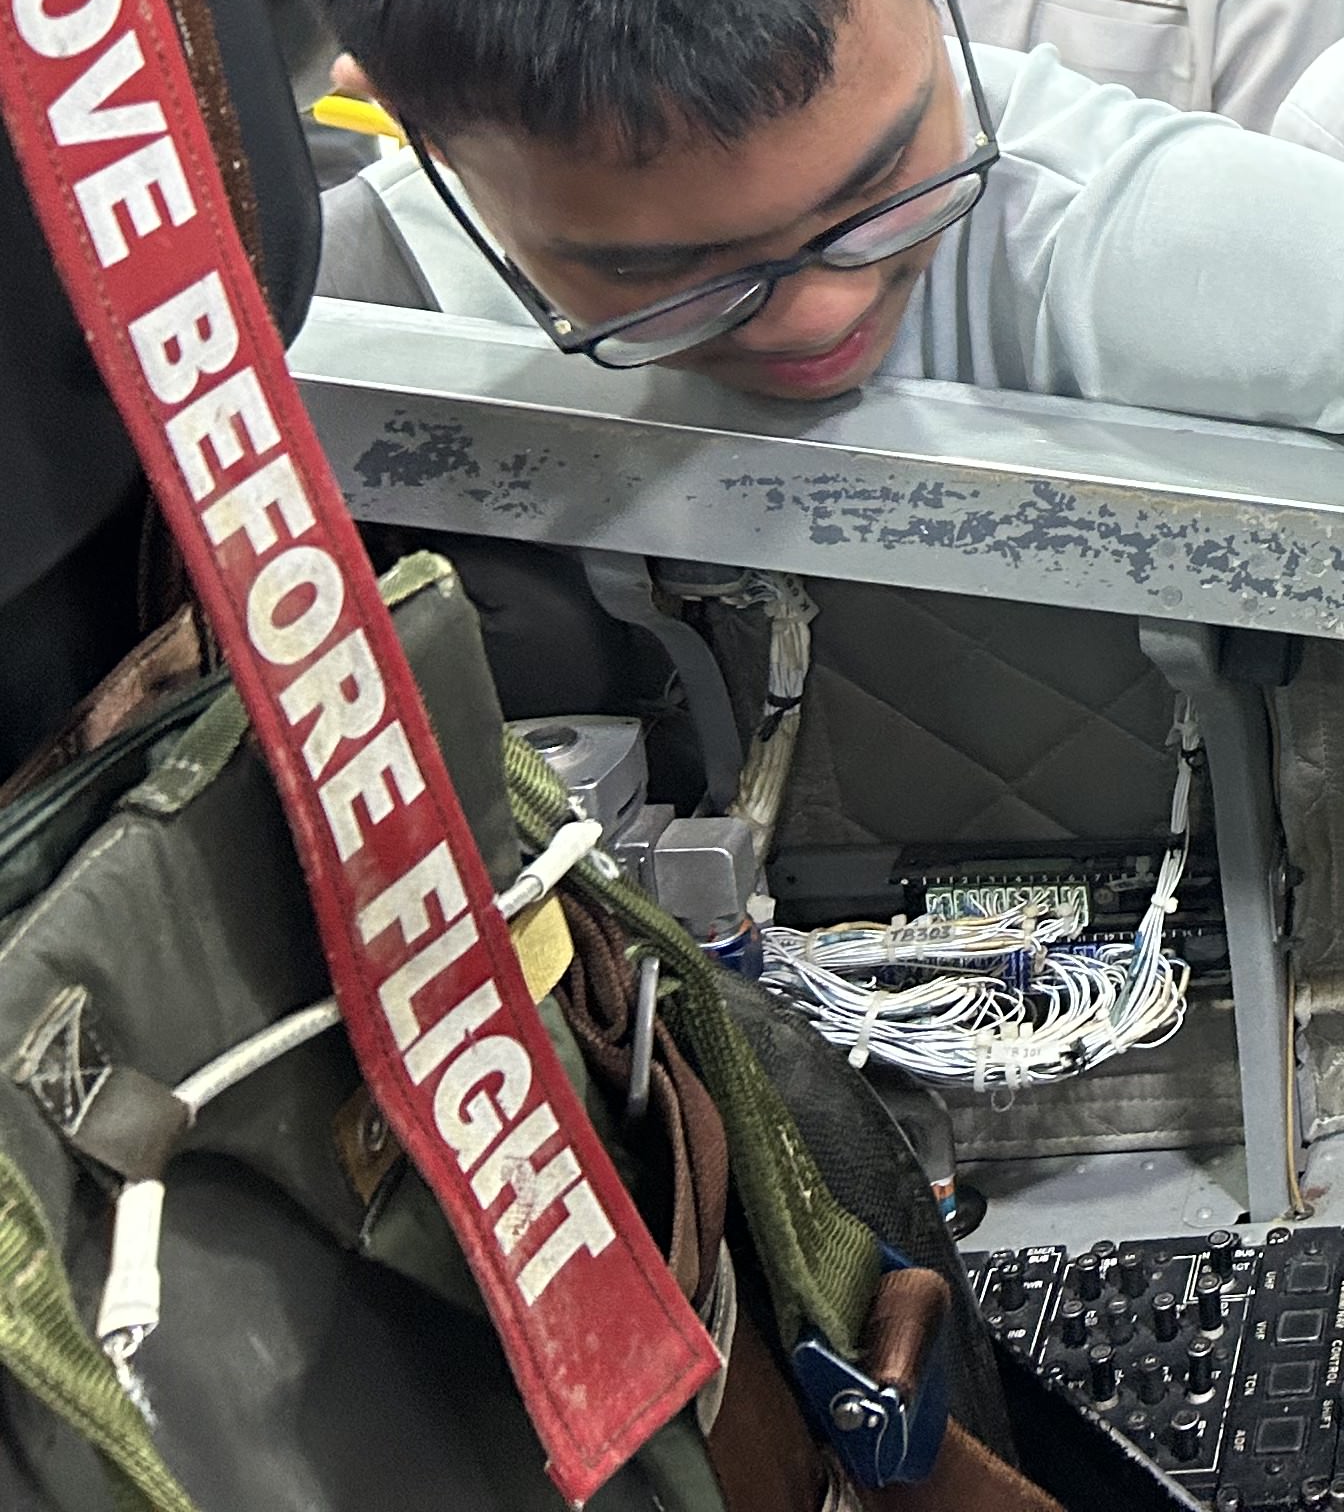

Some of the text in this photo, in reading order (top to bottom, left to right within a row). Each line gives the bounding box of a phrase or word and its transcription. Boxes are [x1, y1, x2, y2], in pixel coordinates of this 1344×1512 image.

[128, 271, 428, 864] BEFORE
[356, 837, 618, 1307] FLIGHT
[1028, 1254, 1050, 1264] BUS
[1264, 1270, 1277, 1290] UHF
[1007, 1328, 1027, 1339] IND
[1256, 1320, 1268, 1340] VHF
[1325, 1339, 1343, 1387] CONTROL
[1244, 1373, 1258, 1396] TCN
[1320, 1399, 1334, 1429] SHIFT
[1234, 1429, 1247, 1453] ADF
